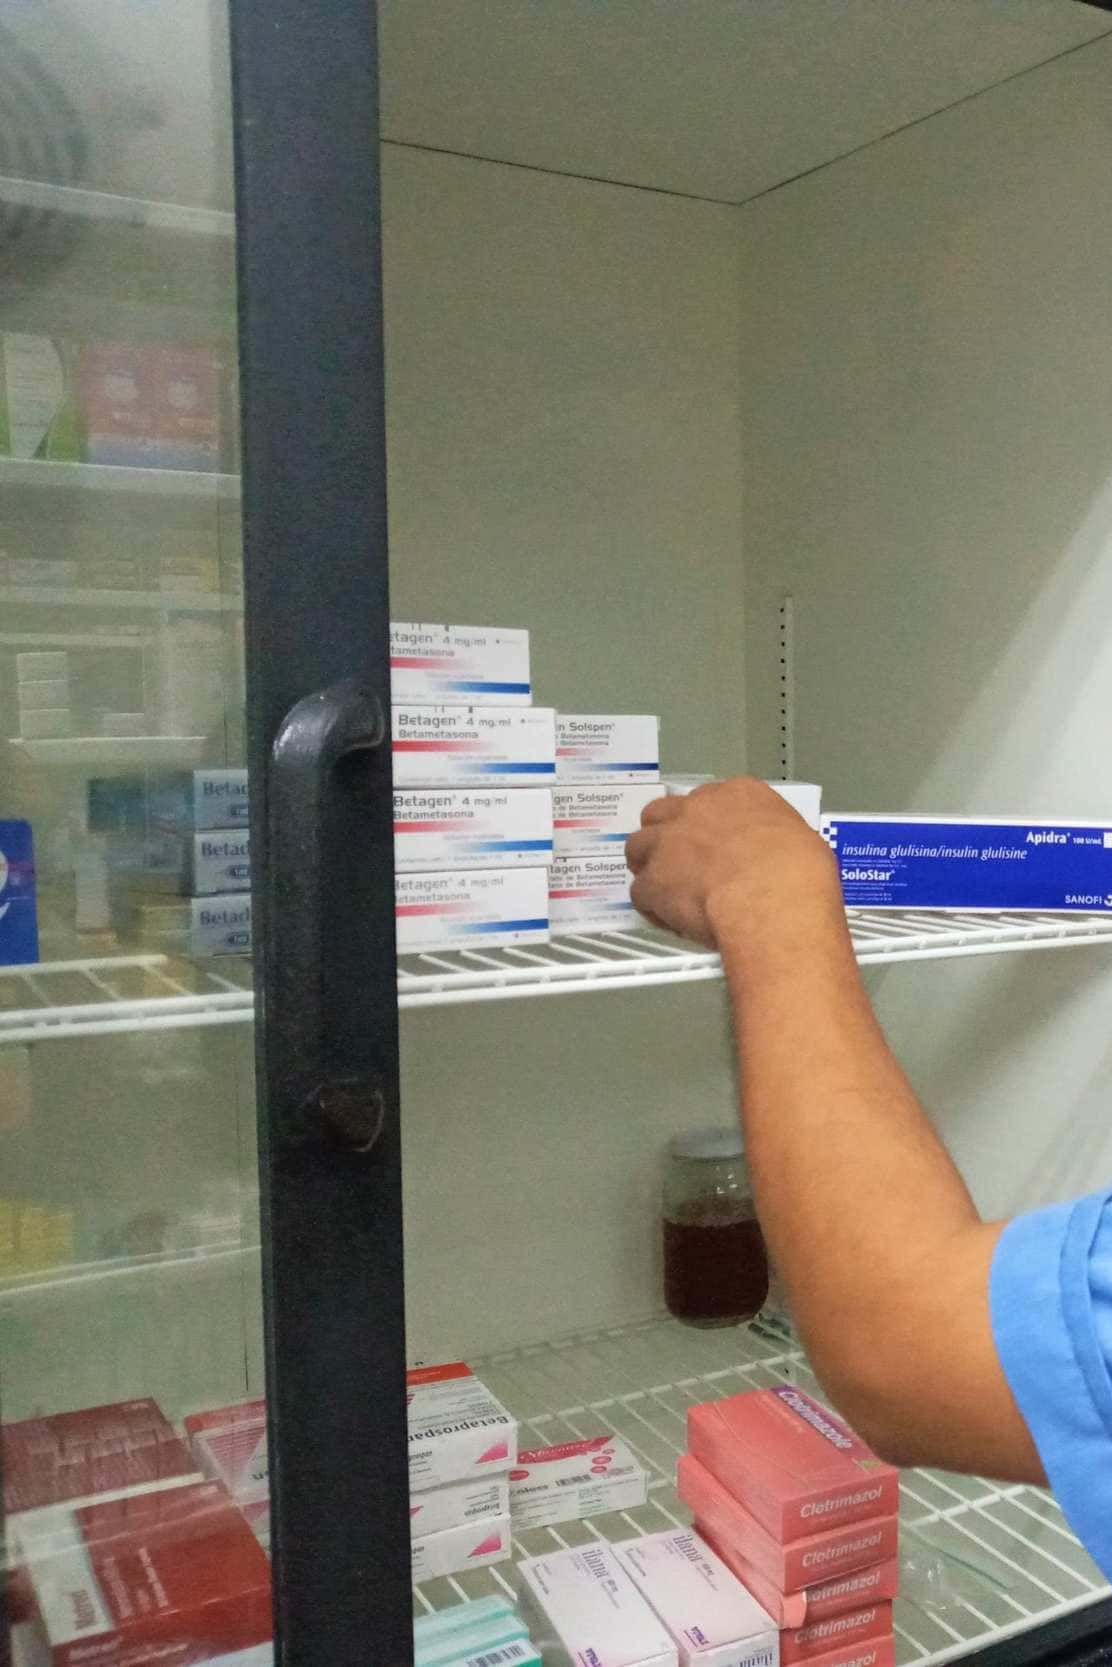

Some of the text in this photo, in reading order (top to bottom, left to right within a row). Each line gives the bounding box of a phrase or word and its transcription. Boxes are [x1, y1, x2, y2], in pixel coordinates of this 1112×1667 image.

[465, 716, 474, 726] 4
[462, 797, 471, 806] 4
[1026, 831, 1067, 846] Apidra
[842, 844, 1028, 861] insulina glulisina/insulin glulisine
[841, 868, 892, 881] SoloStar
[1065, 895, 1102, 904] SANOFI
[801, 1486, 882, 1518] Clotrimazol
[802, 1531, 882, 1567] Clotrimazol
